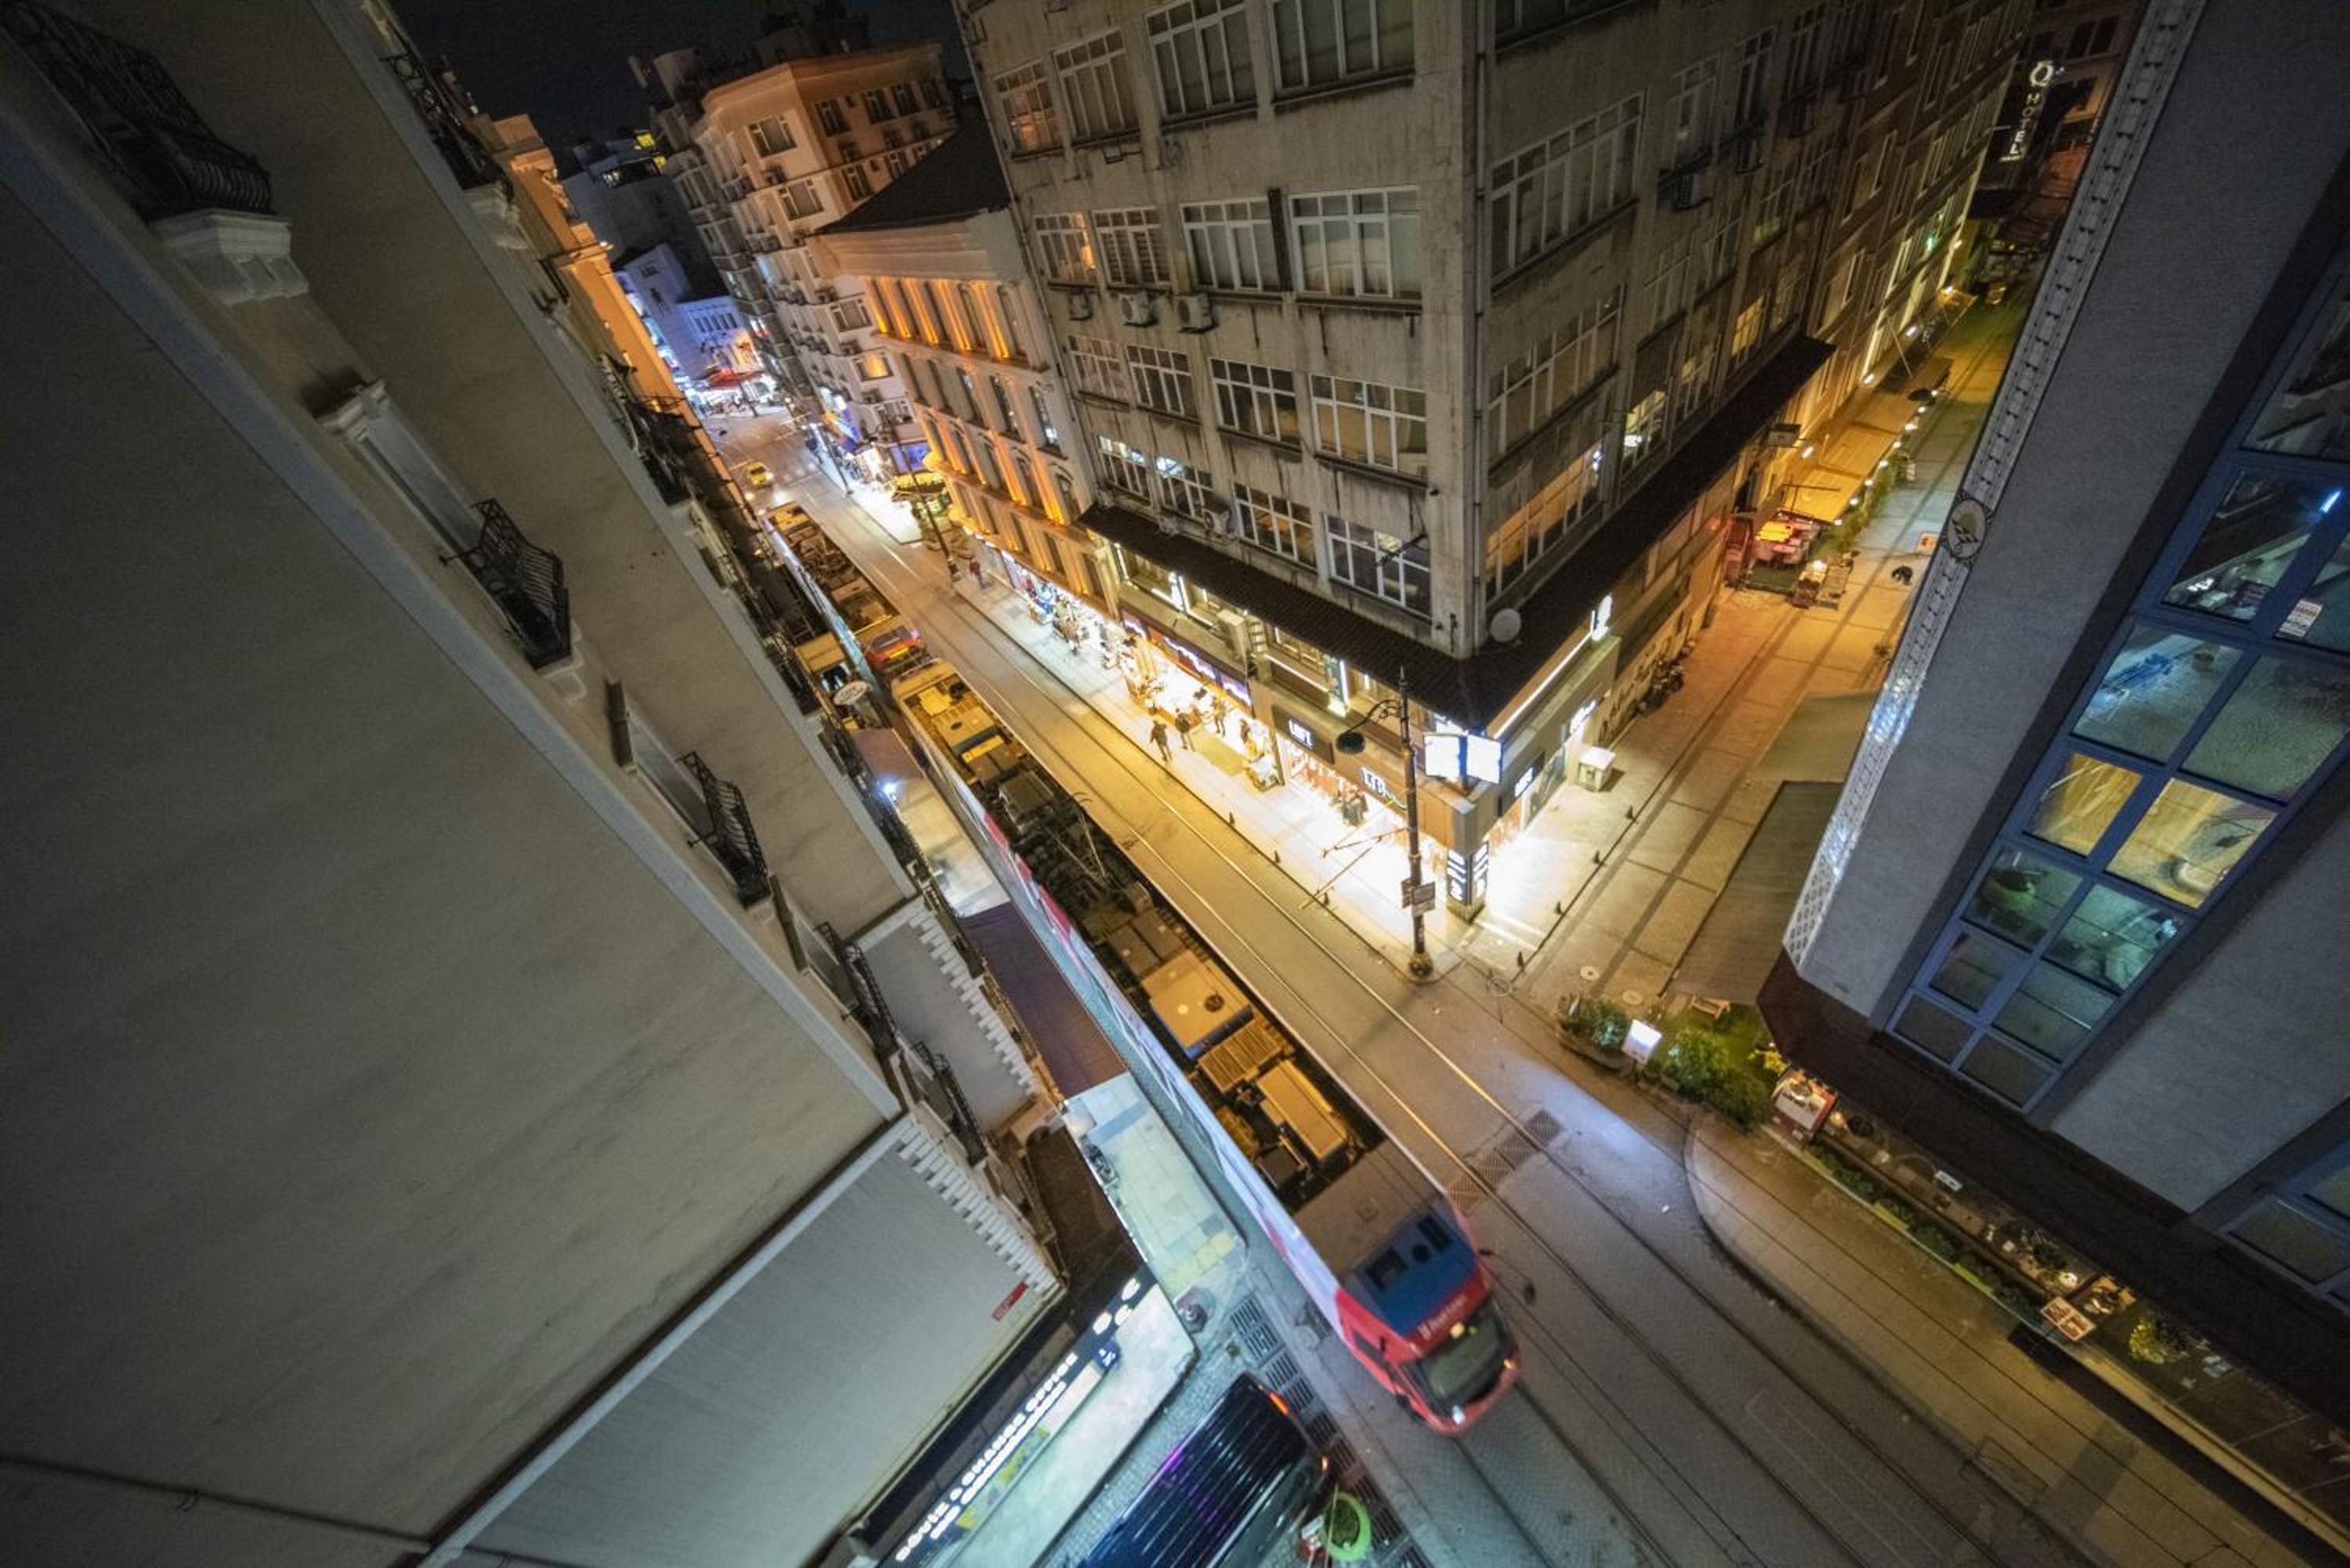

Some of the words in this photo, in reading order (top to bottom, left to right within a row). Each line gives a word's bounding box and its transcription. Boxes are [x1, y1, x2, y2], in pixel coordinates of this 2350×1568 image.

[2010, 93, 2039, 154] HOTEL
[962, 1412, 1026, 1486] CHANGE
[1026, 1353, 1078, 1412] OFFICE
